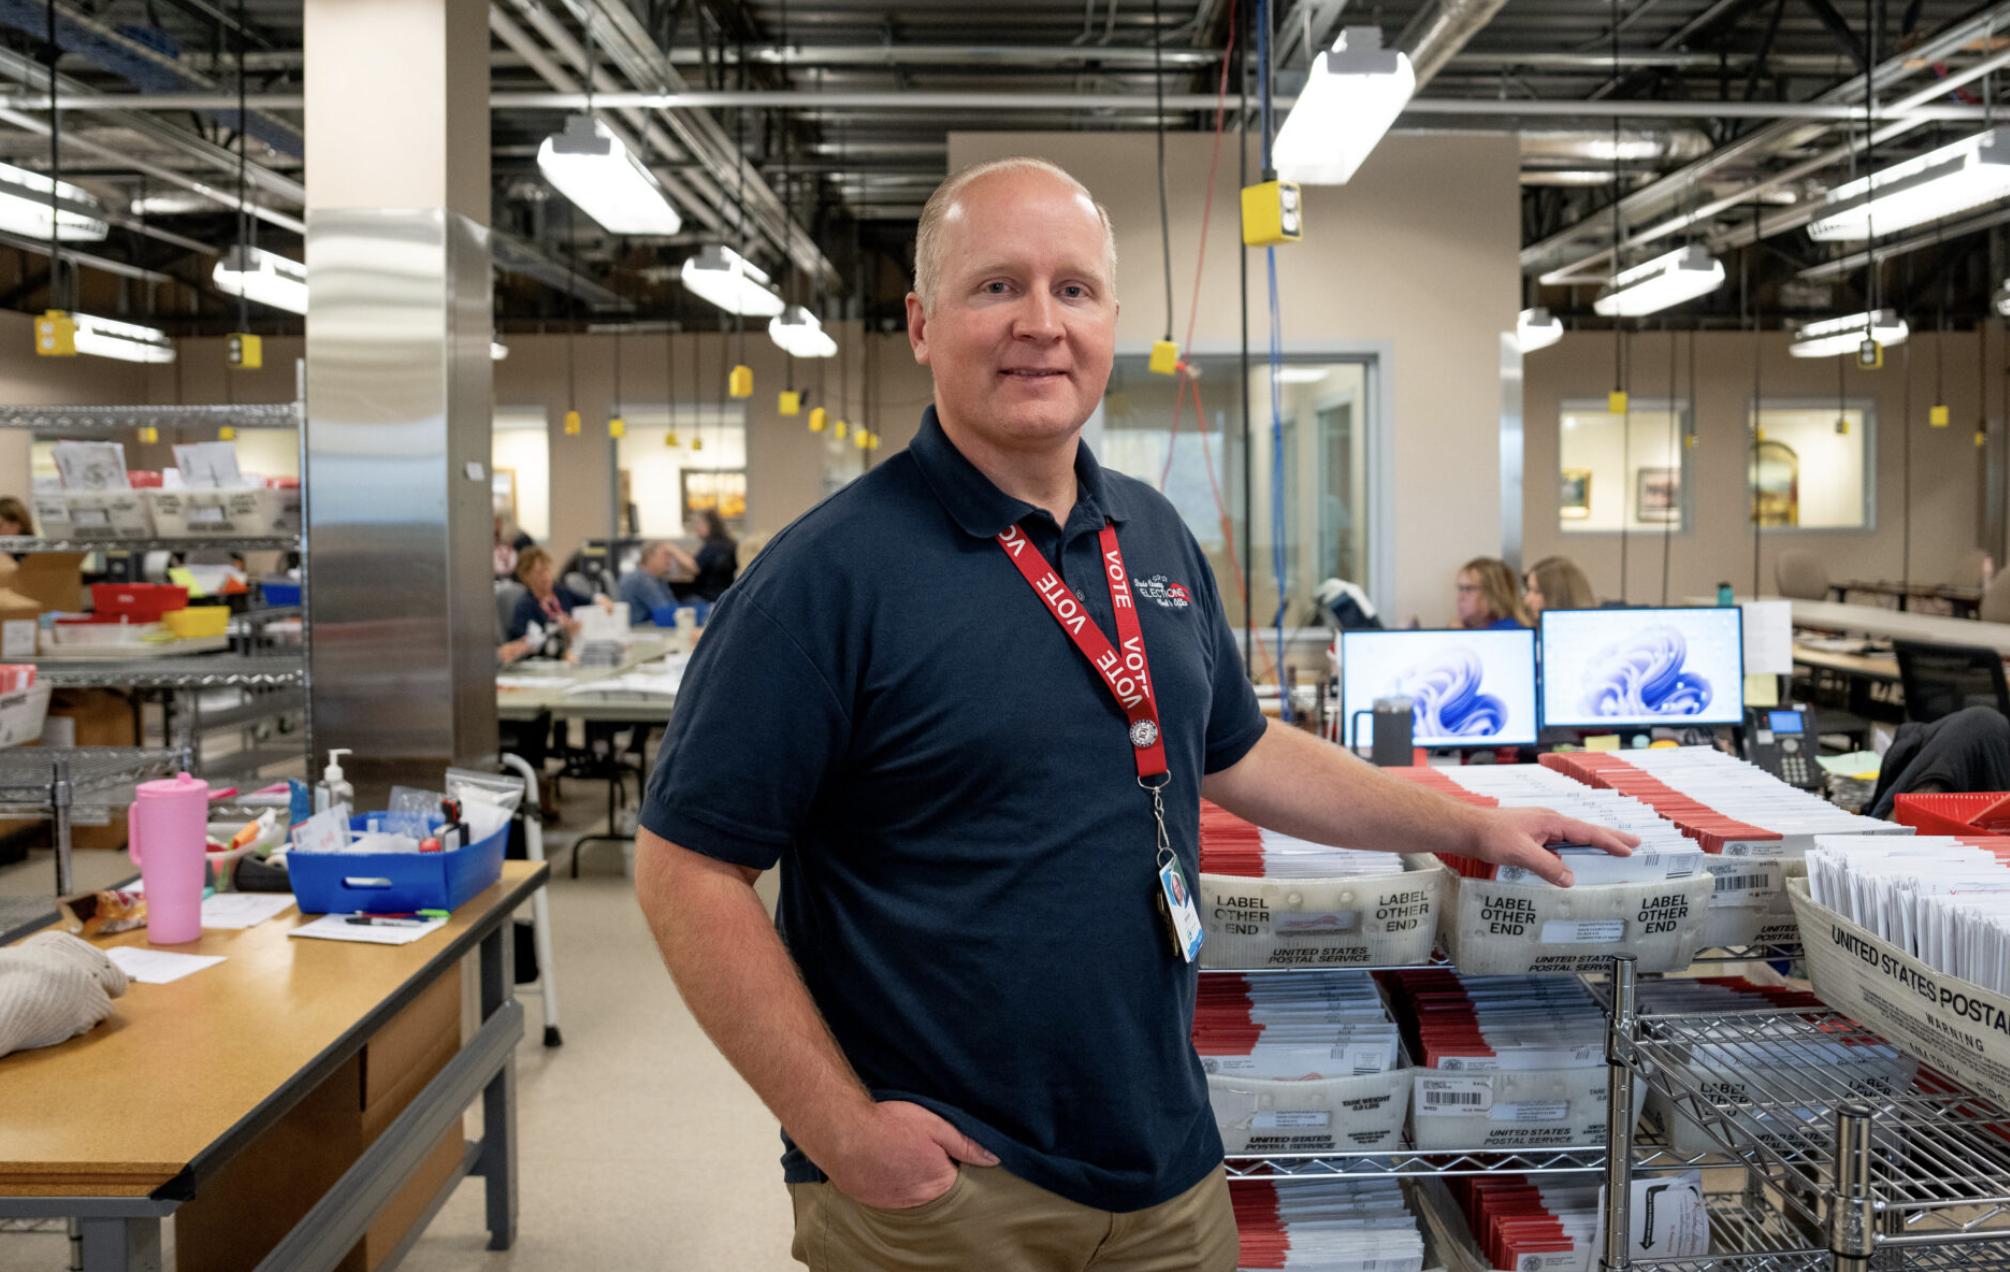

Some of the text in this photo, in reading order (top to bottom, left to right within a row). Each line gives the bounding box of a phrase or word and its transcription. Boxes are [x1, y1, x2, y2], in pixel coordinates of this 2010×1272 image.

[999, 524, 1025, 557] VO
[1106, 550, 1132, 609] VOTE
[1036, 572, 1086, 635] VOTE
[1097, 650, 1143, 709] VOTE
[1217, 895, 1269, 909] LABEL
[1379, 890, 1428, 907] LABEL
[1484, 895, 1536, 912] LABEL
[1641, 894, 1689, 910] LABEL
[1214, 908, 1270, 922] OTHER
[1376, 903, 1429, 920] OTHER
[1480, 909, 1536, 925] OTHER
[1637, 907, 1688, 923] OTHER
[1225, 923, 1259, 936] END
[1386, 918, 1417, 933] END
[1490, 922, 1524, 936] END
[1645, 921, 1677, 934] END
[1273, 946, 1368, 956] UNITED STATES
[1268, 954, 1372, 964] POSTAL SERVICE
[1578, 955, 1614, 963] STATE
[1529, 964, 1574, 972] POSTAL
[1831, 924, 1879, 967] UNITED
[1881, 953, 1937, 1002] STATES
[1939, 986, 2010, 1037] POSTA
[1925, 1011, 1985, 1052] WARNING
[1702, 1094, 1749, 1104] THER
[1291, 1135, 1332, 1143] STATES
[1489, 1127, 1571, 1137] UNITED STATES
[1245, 1142, 1336, 1151] POSTAL SERVICE
[1484, 1136, 1574, 1145] POSTAL SERVICE
